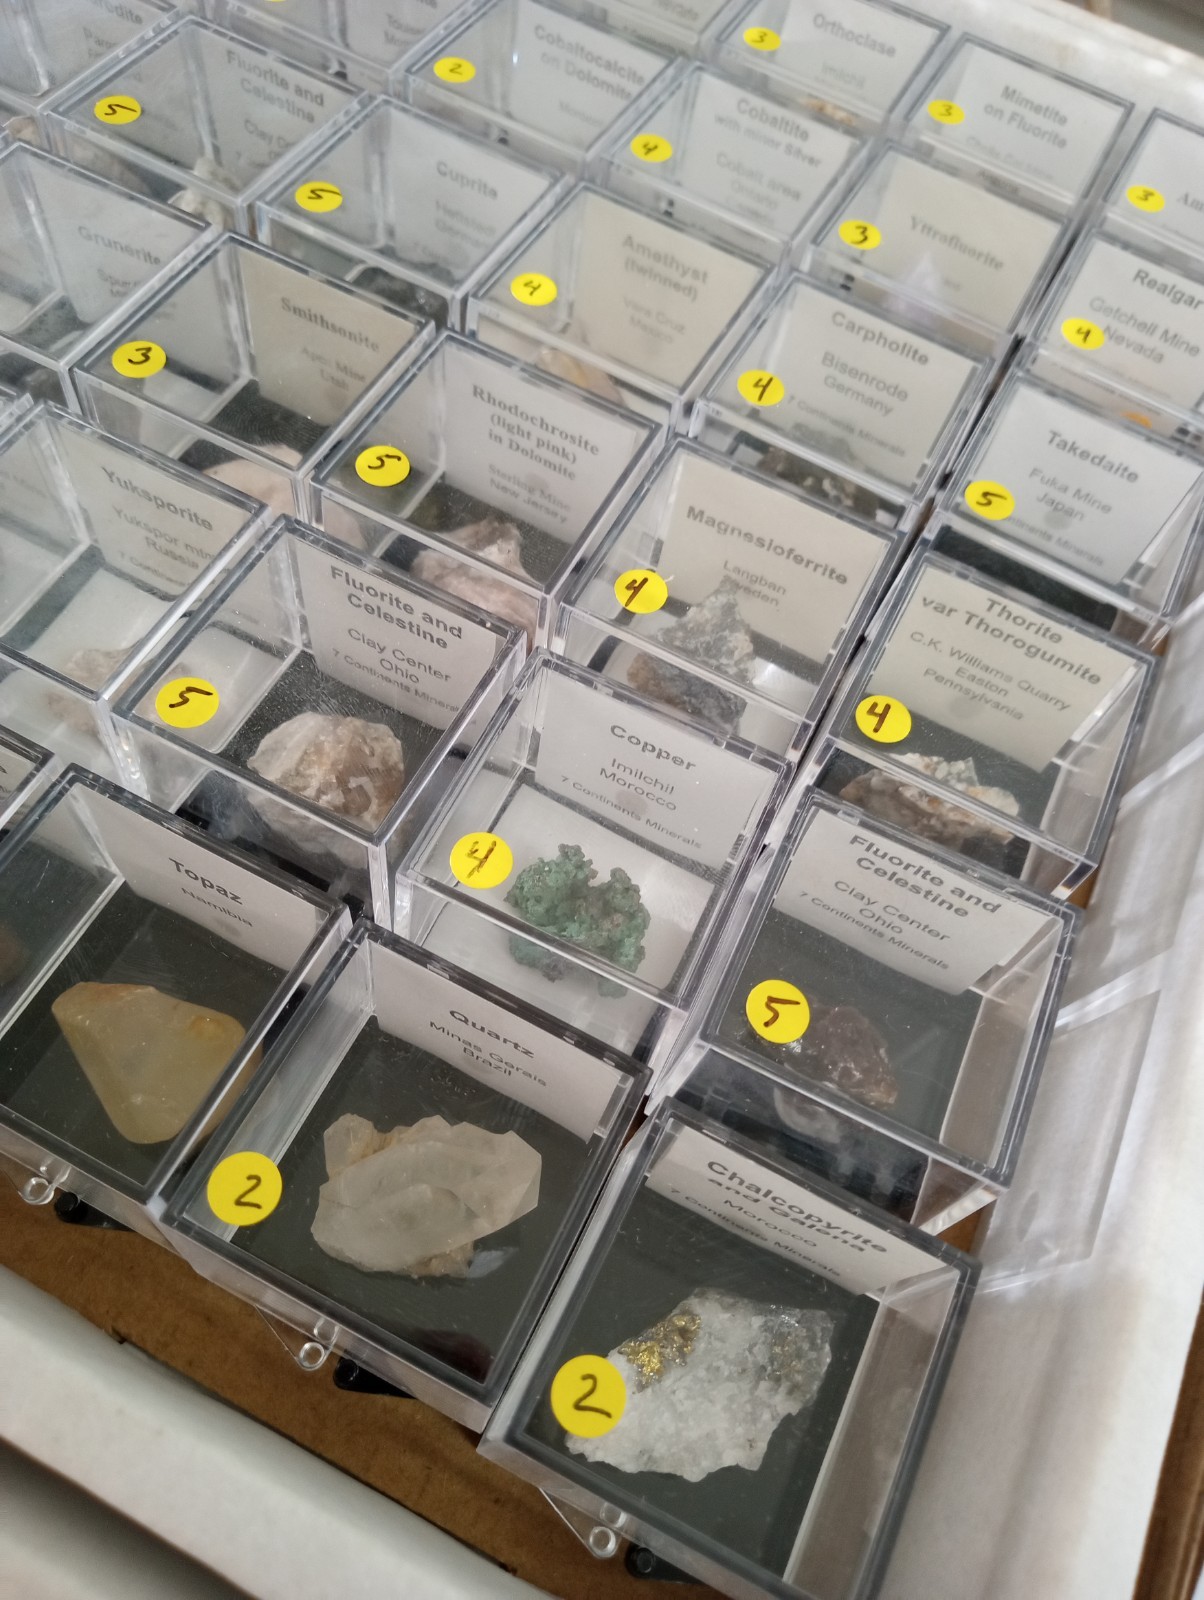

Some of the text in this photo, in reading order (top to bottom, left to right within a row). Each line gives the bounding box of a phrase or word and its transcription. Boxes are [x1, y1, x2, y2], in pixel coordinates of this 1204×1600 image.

[534, 24, 645, 86] Cobaltocalcite
[752, 31, 768, 44] 3
[814, 14, 896, 58] Orthoclase
[226, 51, 324, 106] Fluorite and
[449, 63, 463, 76] 2
[565, 59, 633, 100] Dolomite
[240, 78, 315, 123] Celestine
[737, 99, 810, 142] Cobaltite
[939, 104, 953, 117] 3
[1001, 85, 1068, 127] Mimetite
[642, 142, 658, 156] 4
[984, 104, 1068, 150] on Fluorite
[436, 161, 498, 200] Cuprite
[1136, 190, 1155, 201] 3
[78, 225, 160, 265] Grunerite
[851, 225, 868, 244] 3
[622, 235, 708, 284] Amethyst
[624, 256, 698, 303] (twinned)
[1134, 268, 1204, 310] Realgar
[281, 296, 380, 352] Smithsonite
[832, 312, 929, 366] Carpholite
[1076, 326, 1091, 343] 4
[1089, 296, 1200, 357] Getchell Mine
[1103, 325, 1164, 364] Nevada
[128, 347, 152, 365] 3
[822, 351, 908, 402] Bisenrode
[753, 377, 774, 402] 4
[824, 375, 894, 416] Germany
[472, 384, 599, 456] Rhodochrosite
[490, 413, 577, 464] (light pink)
[368, 454, 401, 470] 5
[489, 429, 576, 480] in Dolomite
[1048, 430, 1139, 483] Takedaite
[102, 466, 213, 531] Yuksporite
[490, 478, 519, 498] New
[976, 491, 1008, 506] 5
[1028, 468, 1112, 514] Fuka Mine
[1037, 492, 1085, 521] Japan
[686, 505, 848, 585] Magnesioferrite
[1004, 514, 1052, 542] ntinents
[625, 578, 648, 607] 4
[723, 560, 786, 596] Langban
[330, 565, 462, 640] Fluorite and
[347, 593, 448, 649] Celestine
[987, 598, 1062, 644] Thorite
[348, 628, 452, 682] Clay Center
[922, 597, 1102, 686] var Thorogumite
[331, 648, 340, 657] 7
[344, 655, 410, 693] Continents
[379, 658, 420, 683] Ohio
[910, 631, 1071, 712] C.K. Williams Quarry
[955, 667, 1009, 698] Easton
[923, 667, 1024, 720] Pennsylvania
[866, 702, 891, 733] 4
[610, 724, 696, 770] Copper
[600, 768, 677, 811] Morocco
[611, 758, 674, 795] Imilchil
[572, 782, 641, 821] Continents
[645, 818, 702, 848] Minerals
[169, 857, 243, 905] Topaz
[465, 840, 497, 878] 4
[850, 834, 1002, 914] Fluorite and
[181, 887, 253, 927] Namibia
[856, 857, 969, 918] Celestine
[834, 880, 950, 941] Clay Center
[859, 908, 903, 934] Ohio
[811, 897, 885, 939] Continents
[888, 936, 949, 970] Minerals
[450, 1010, 534, 1058] Quartz
[763, 996, 801, 1028] 5
[430, 1021, 546, 1086] Minas Gerais
[463, 1047, 512, 1076] Brazil
[234, 1175, 262, 1209] 2
[707, 1161, 888, 1253] Chalcopyrite
[685, 1196, 769, 1242] Continents
[774, 1241, 840, 1277] Minerals
[708, 1178, 866, 1252] and Galena
[724, 1199, 817, 1247] Morocco
[573, 1374, 612, 1418] 2
